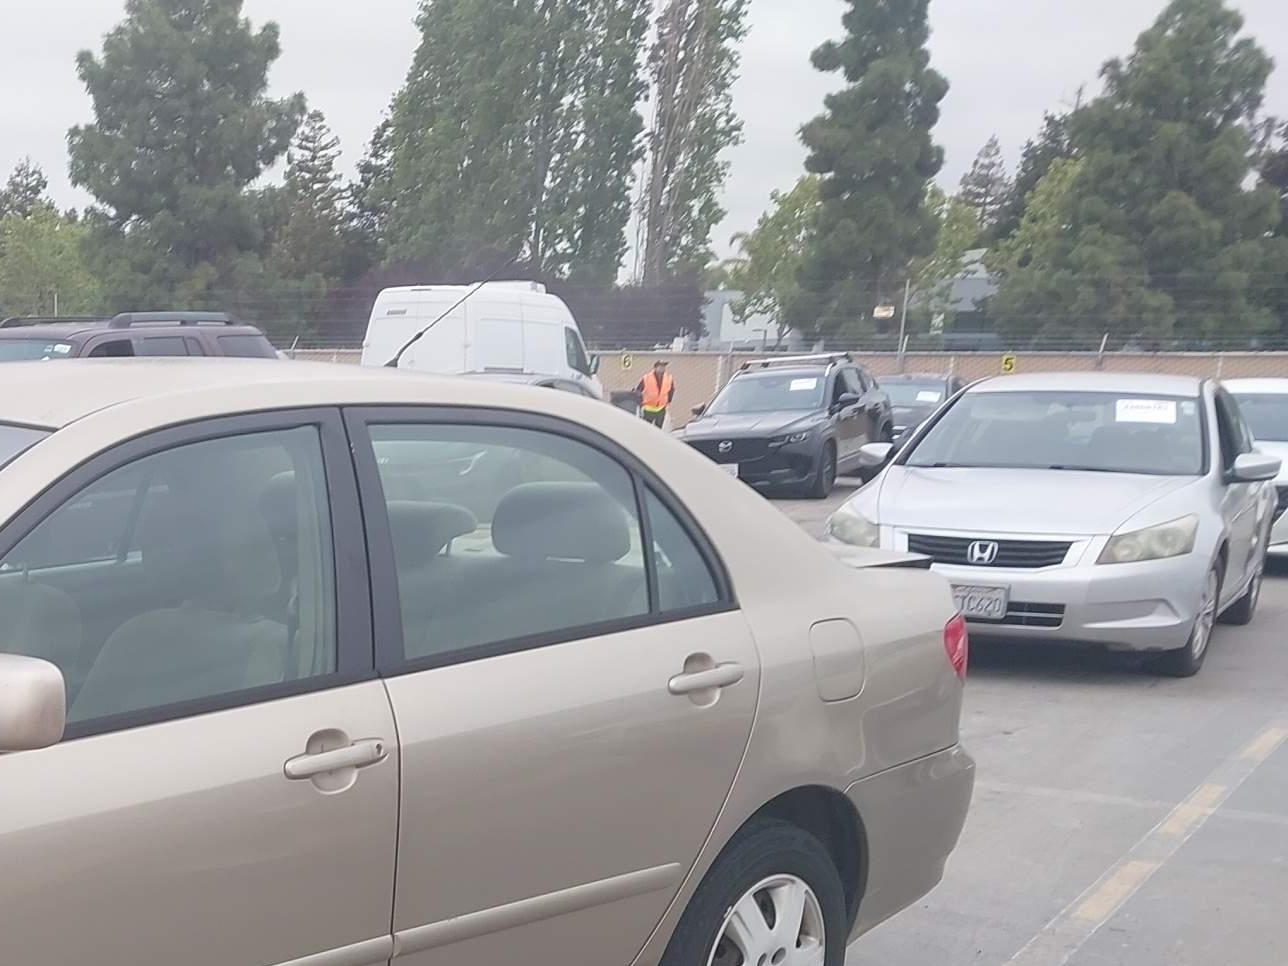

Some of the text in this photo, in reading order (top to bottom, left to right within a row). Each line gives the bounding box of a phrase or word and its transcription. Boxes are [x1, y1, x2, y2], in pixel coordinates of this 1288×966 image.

[623, 354, 631, 368] 6
[1004, 357, 1014, 371] 5
[954, 595, 1001, 616] TC620
